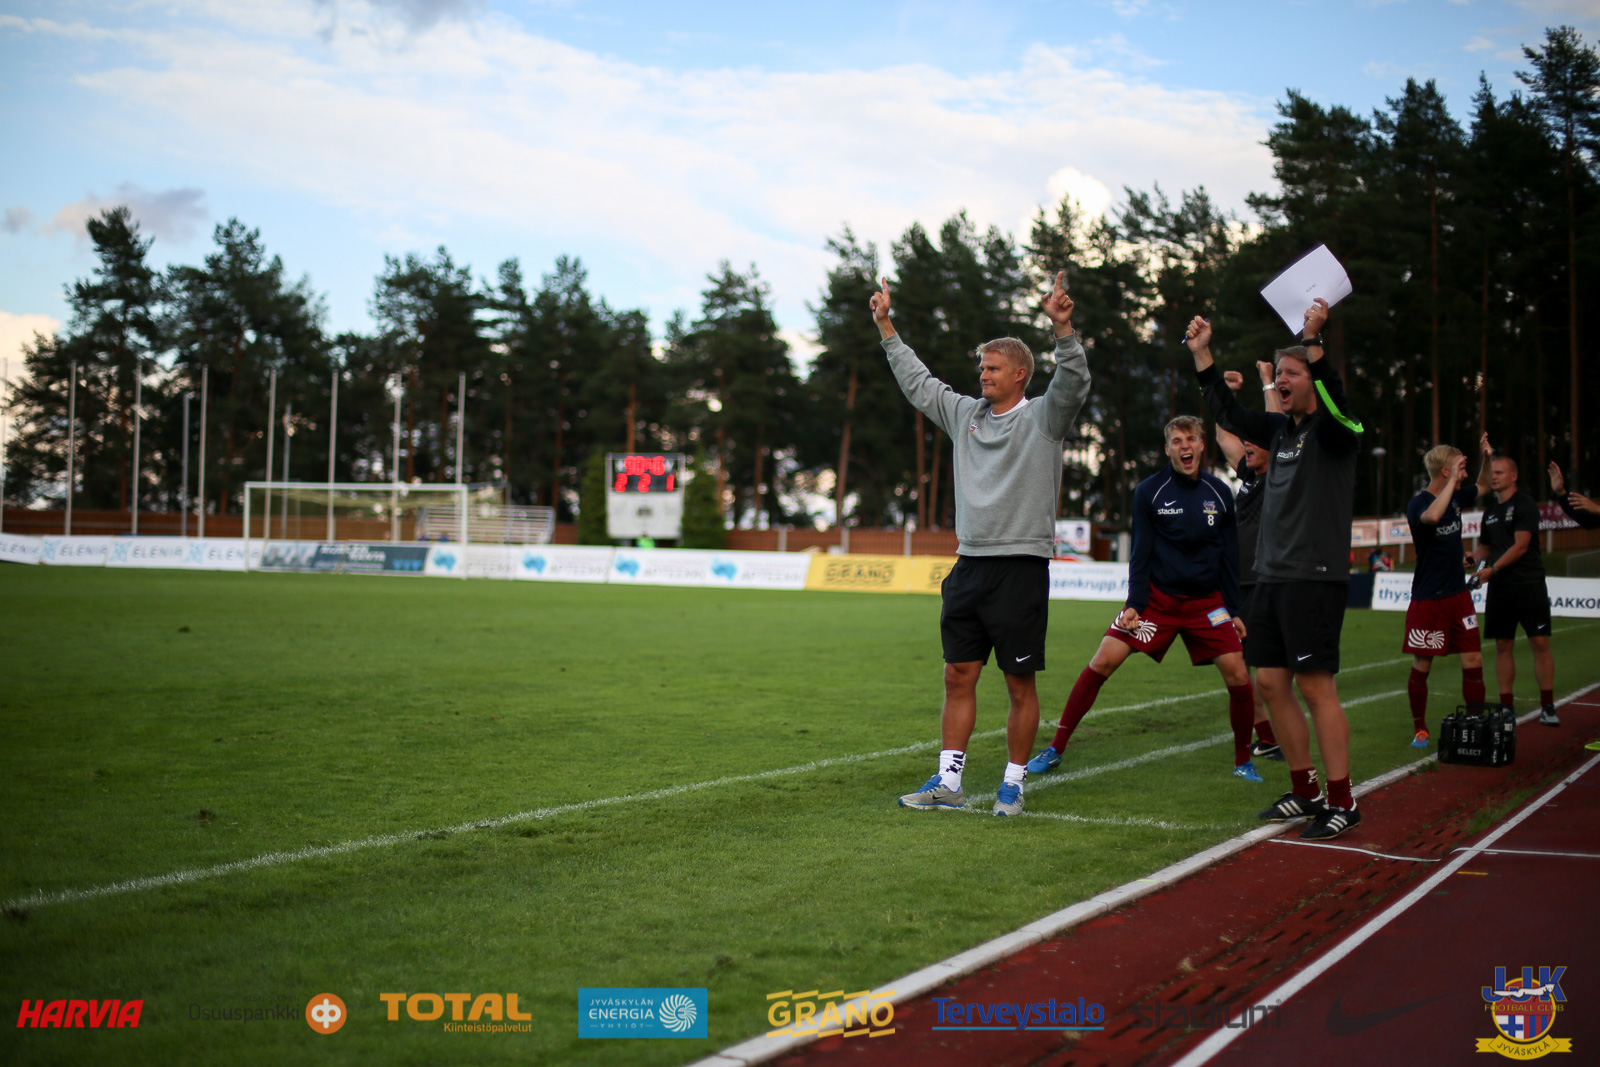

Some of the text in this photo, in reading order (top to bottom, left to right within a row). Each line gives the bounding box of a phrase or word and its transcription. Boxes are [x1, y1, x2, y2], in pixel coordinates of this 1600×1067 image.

[614, 473, 675, 493] 2 2 1
[1207, 514, 1215, 526] 8
[60, 543, 107, 557] ELENIA
[132, 545, 183, 559] ELENIA
[824, 566, 895, 582] GRANO
[1457, 748, 1481, 756] SELECT
